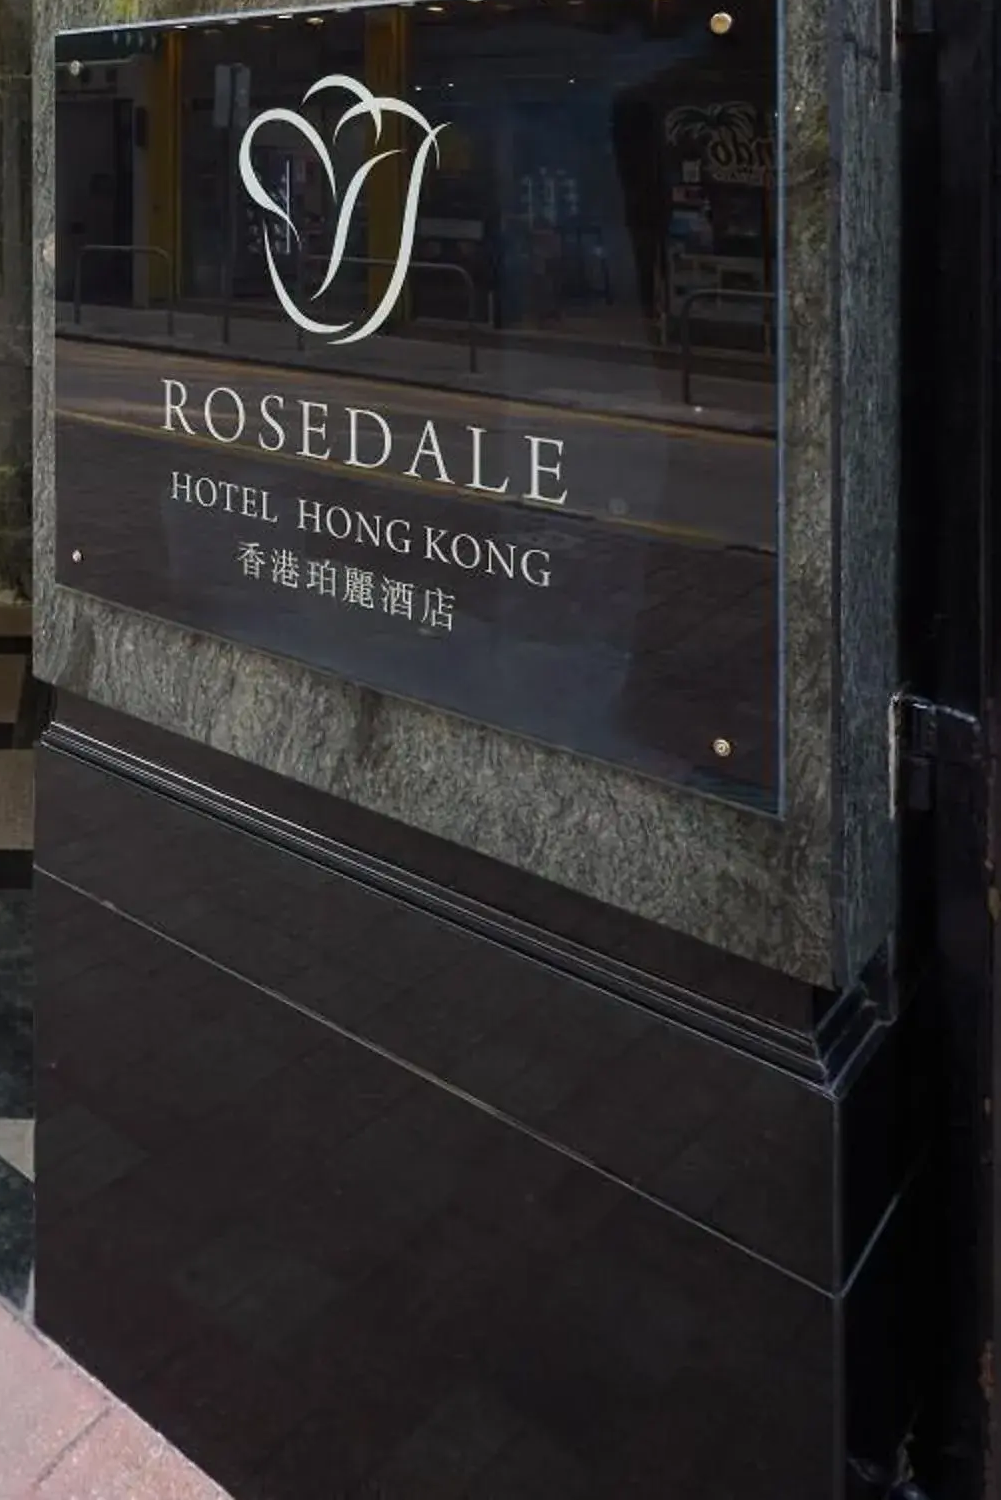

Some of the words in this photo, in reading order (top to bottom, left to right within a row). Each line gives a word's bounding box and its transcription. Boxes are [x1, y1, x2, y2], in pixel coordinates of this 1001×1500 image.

[160, 378, 568, 506] ROSEDALE
[170, 471, 279, 524] HOTEL
[296, 496, 412, 555] HONG
[422, 525, 552, 588] KONG
[236, 540, 456, 632] 香港珀麗酒店
